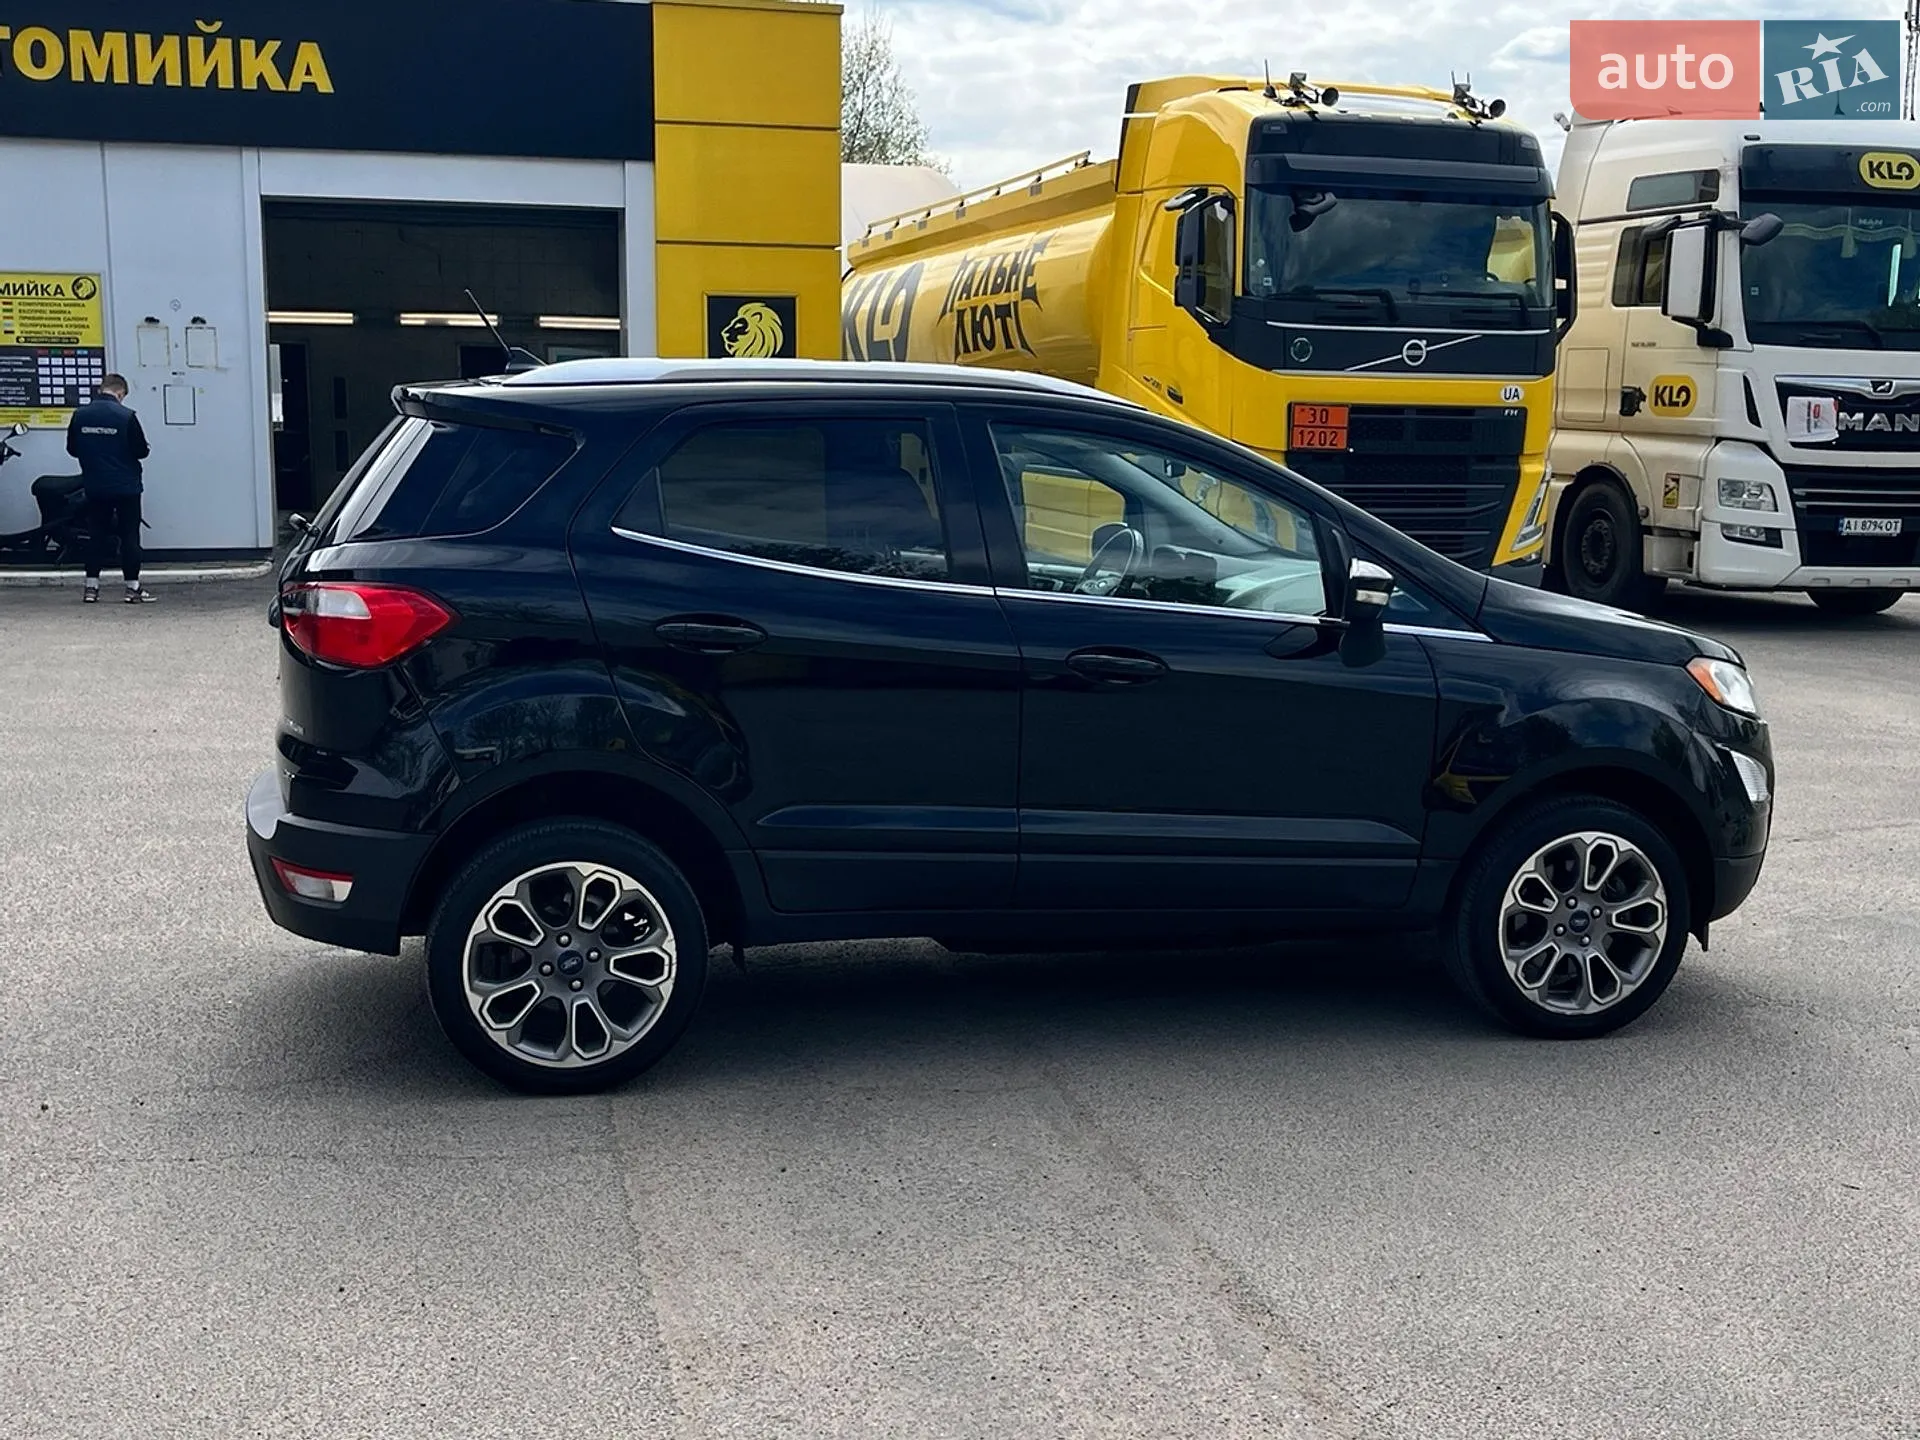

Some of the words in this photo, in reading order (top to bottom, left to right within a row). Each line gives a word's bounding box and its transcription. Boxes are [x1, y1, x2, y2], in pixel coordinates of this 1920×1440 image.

[0, 20, 334, 93] ОМИЙКА
[1868, 160, 1915, 180] KLO
[937, 232, 1057, 327] ПАЛЬНЕ
[954, 300, 1037, 362] ЛЮТІ
[1503, 387, 1520, 401] UA
[1654, 385, 1691, 408] KLO
[1308, 407, 1329, 425] 30
[1838, 412, 1920, 432] MAN
[1298, 430, 1338, 447] 1202
